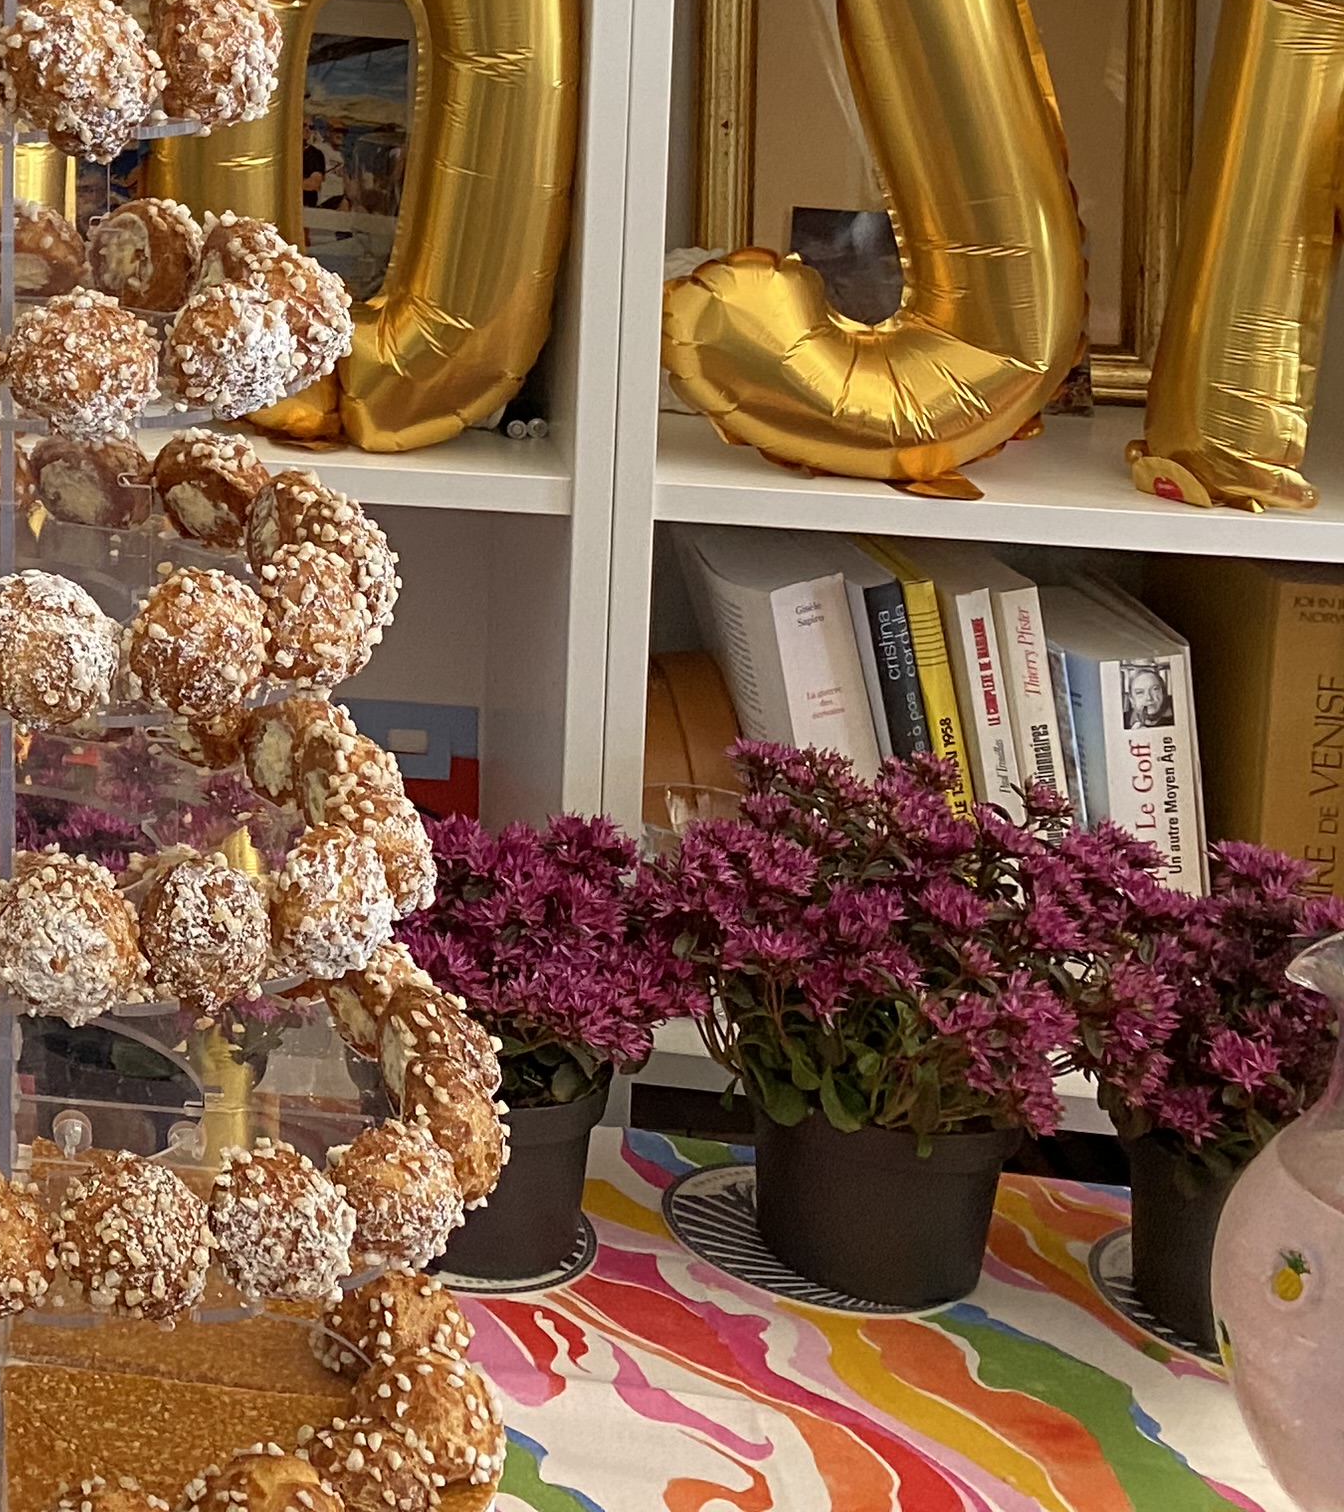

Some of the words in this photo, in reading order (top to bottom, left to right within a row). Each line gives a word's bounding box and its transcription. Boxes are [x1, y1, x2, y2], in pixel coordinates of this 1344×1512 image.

[892, 603, 917, 678] cordula
[1014, 605, 1036, 647] Pfister
[876, 609, 903, 681] cristina
[1021, 648, 1043, 698] Thierry
[904, 690, 925, 722] pas
[938, 716, 957, 746] 1958
[1156, 735, 1177, 763] Âge
[1128, 738, 1154, 794] Goff
[1162, 766, 1181, 814] Moyen
[1134, 802, 1157, 829] Le
[1317, 806, 1340, 835] DE
[1166, 816, 1181, 853] autre
[1167, 855, 1183, 875] Un
